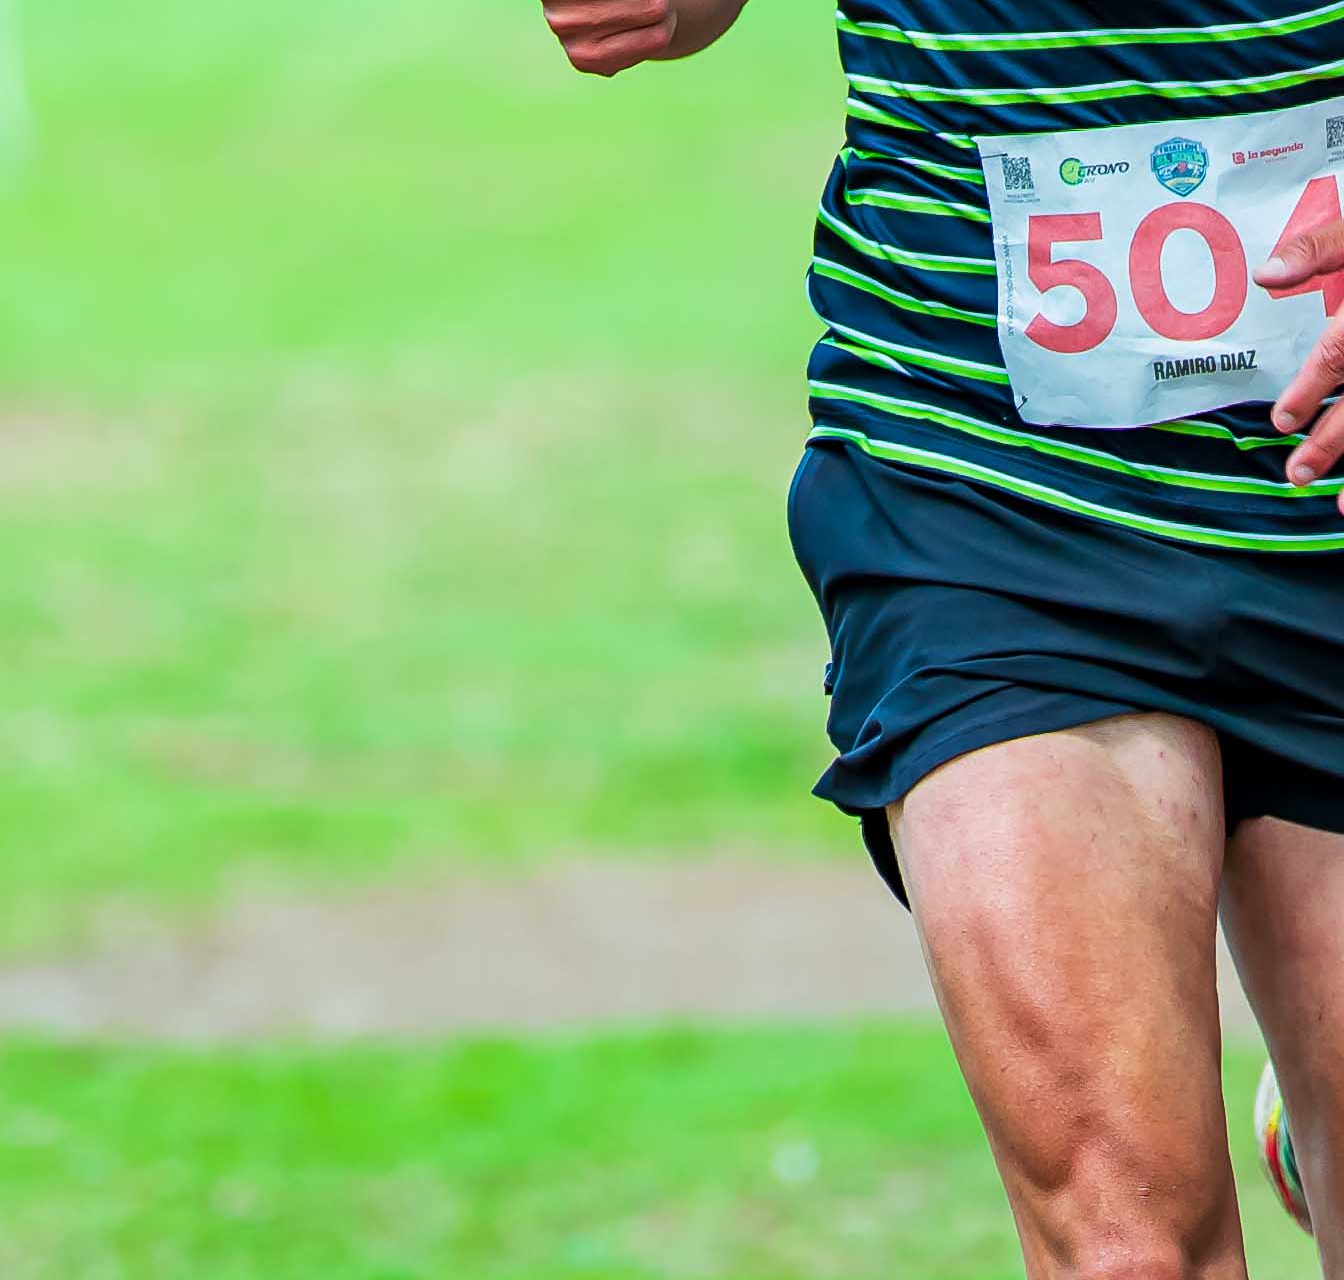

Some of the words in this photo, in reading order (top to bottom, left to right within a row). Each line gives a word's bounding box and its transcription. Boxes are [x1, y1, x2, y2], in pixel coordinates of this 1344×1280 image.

[1248, 150, 1258, 159] la
[1260, 143, 1304, 157] segunda
[1154, 356, 1217, 381] RAMIRO
[1220, 350, 1258, 371] DIAZ
